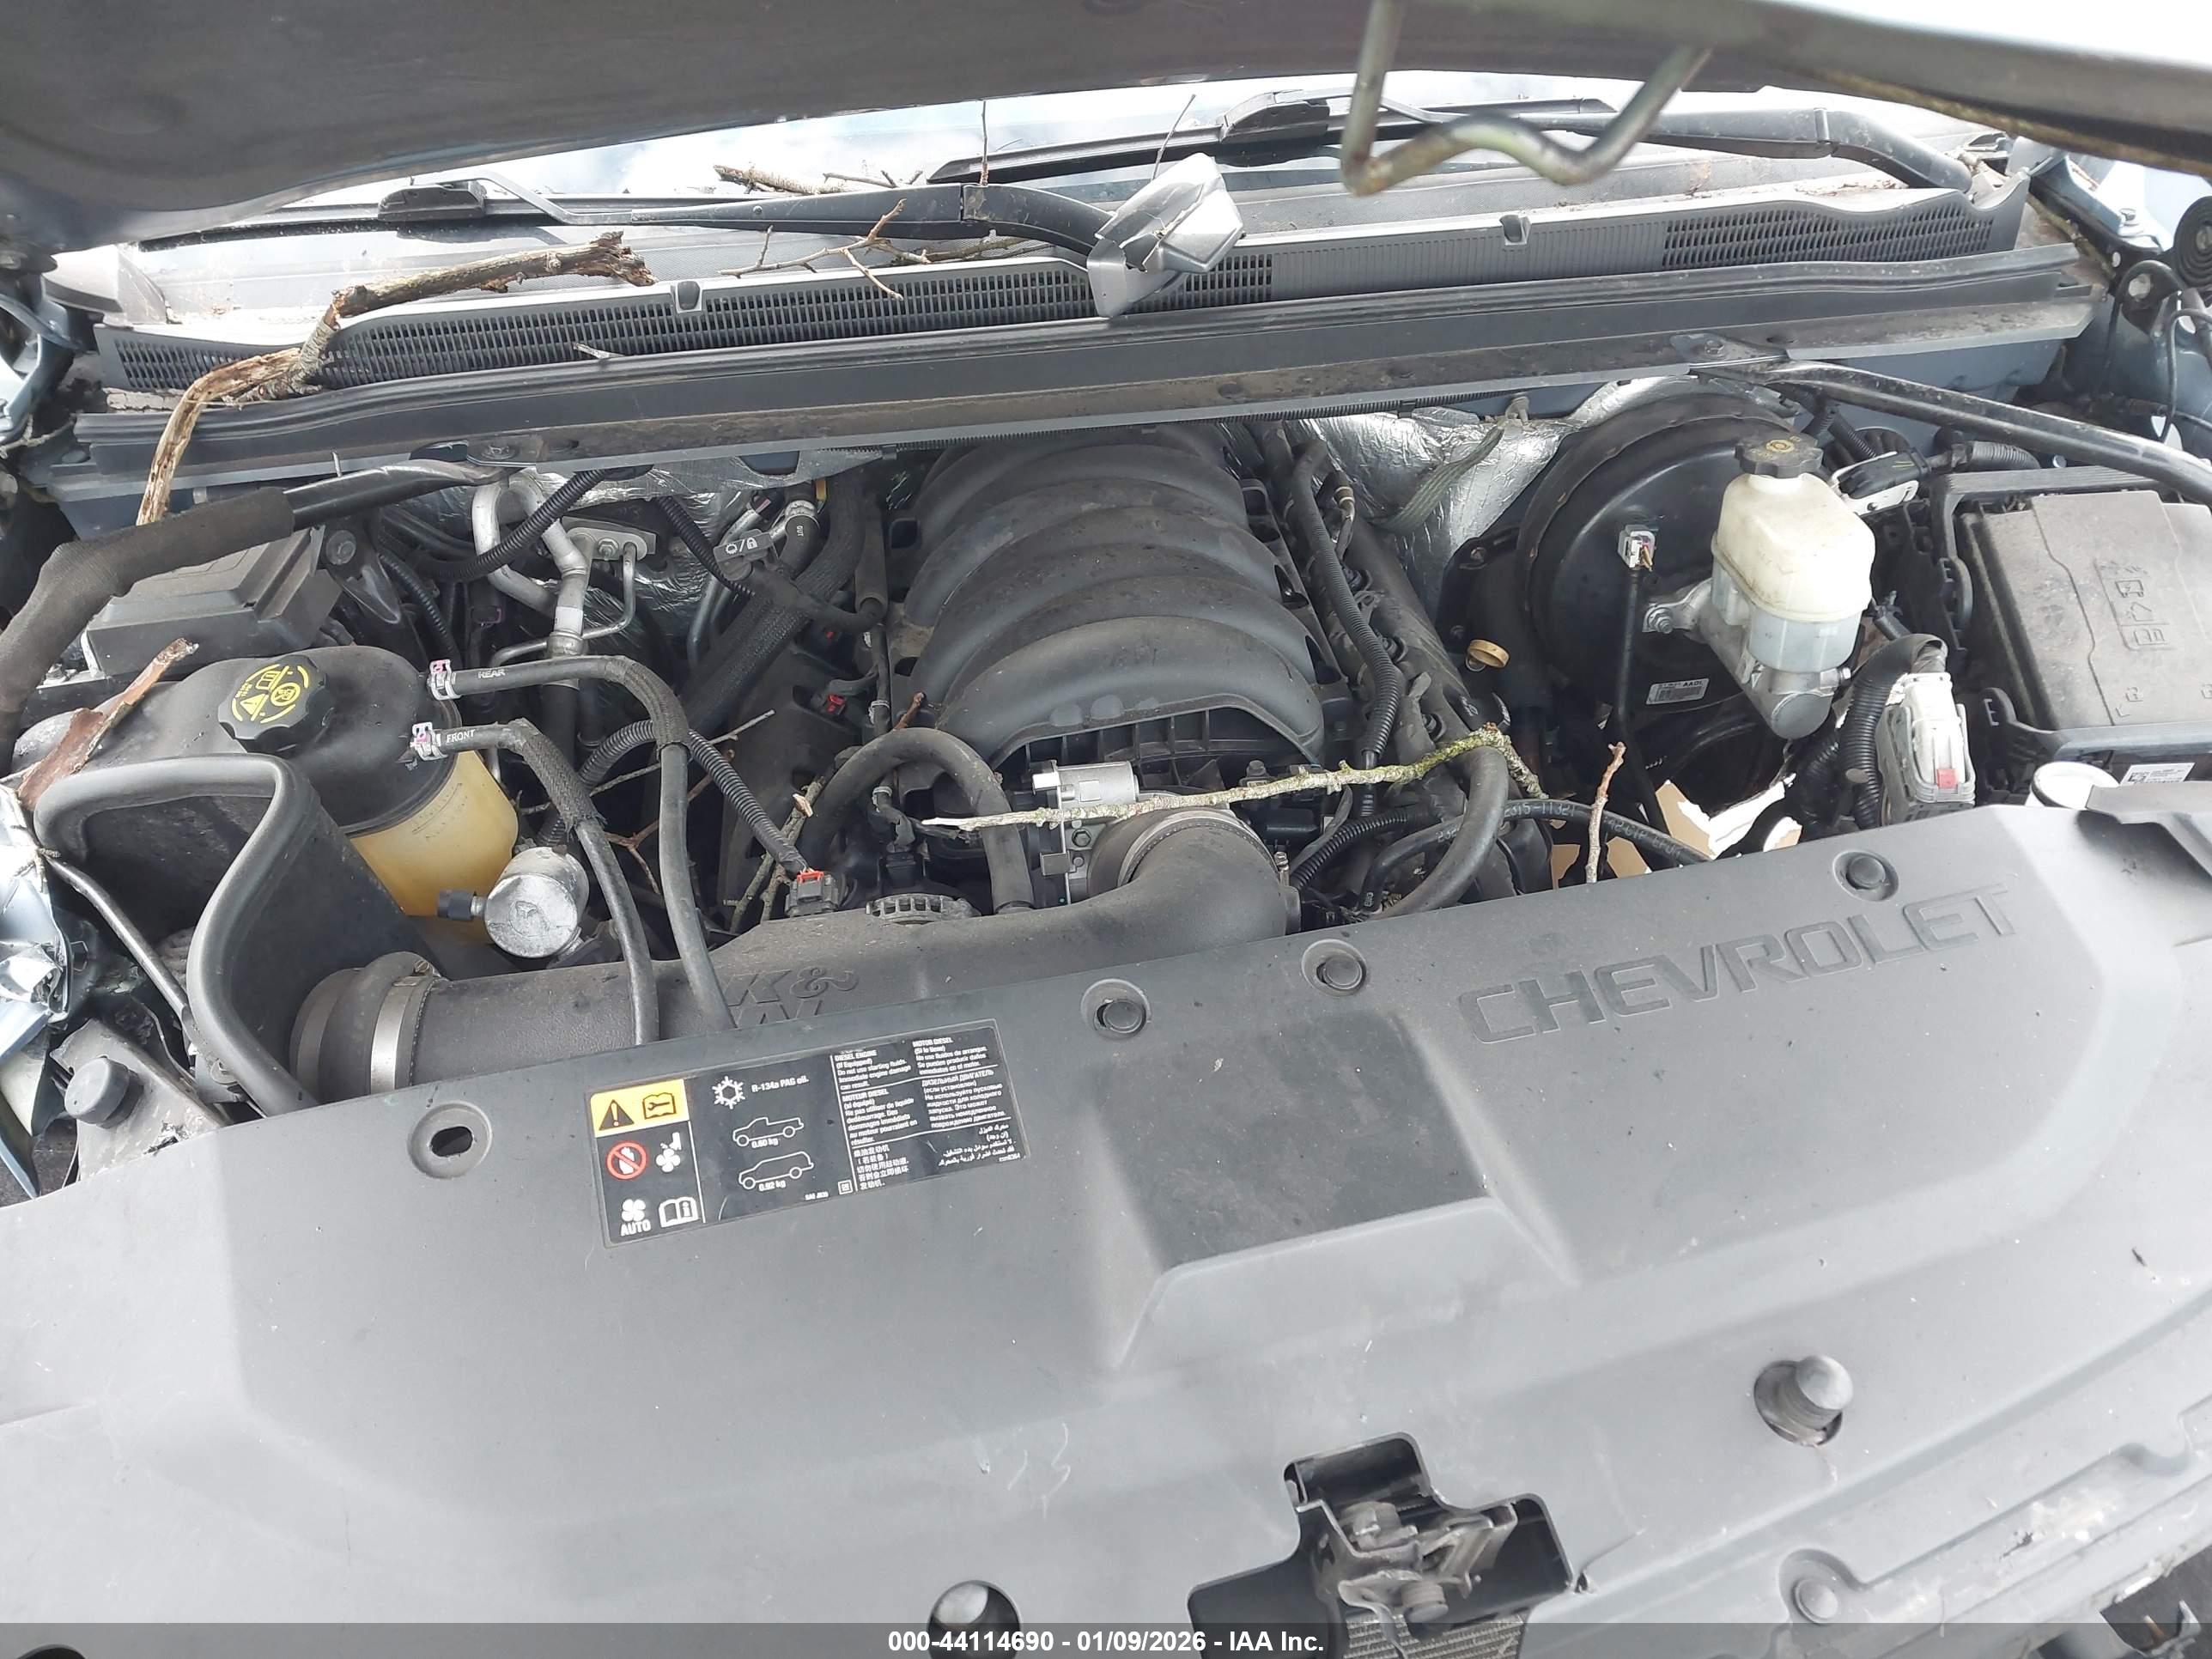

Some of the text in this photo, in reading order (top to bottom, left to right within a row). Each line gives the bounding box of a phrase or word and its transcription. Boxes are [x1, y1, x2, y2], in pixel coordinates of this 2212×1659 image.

[478, 669, 506, 679] REAR
[447, 729, 476, 743] FRONT
[1459, 881, 2018, 1044] CHEVROLET
[912, 1036, 953, 1048] MOTOR DIESEL
[834, 1049, 878, 1061] DIESEL ENGINE
[867, 1063, 890, 1072] starting
[838, 1065, 911, 1084] Immediate engine damage
[959, 1069, 994, 1082] ДВИГАТЕЛЬ
[750, 1075, 810, 1092] R-134a PAG oil.
[842, 1088, 890, 1103] MOTEUR DIESEL
[768, 1138, 779, 1146] kg
[775, 1180, 787, 1189] kg
[620, 1218, 652, 1237] AUTO
